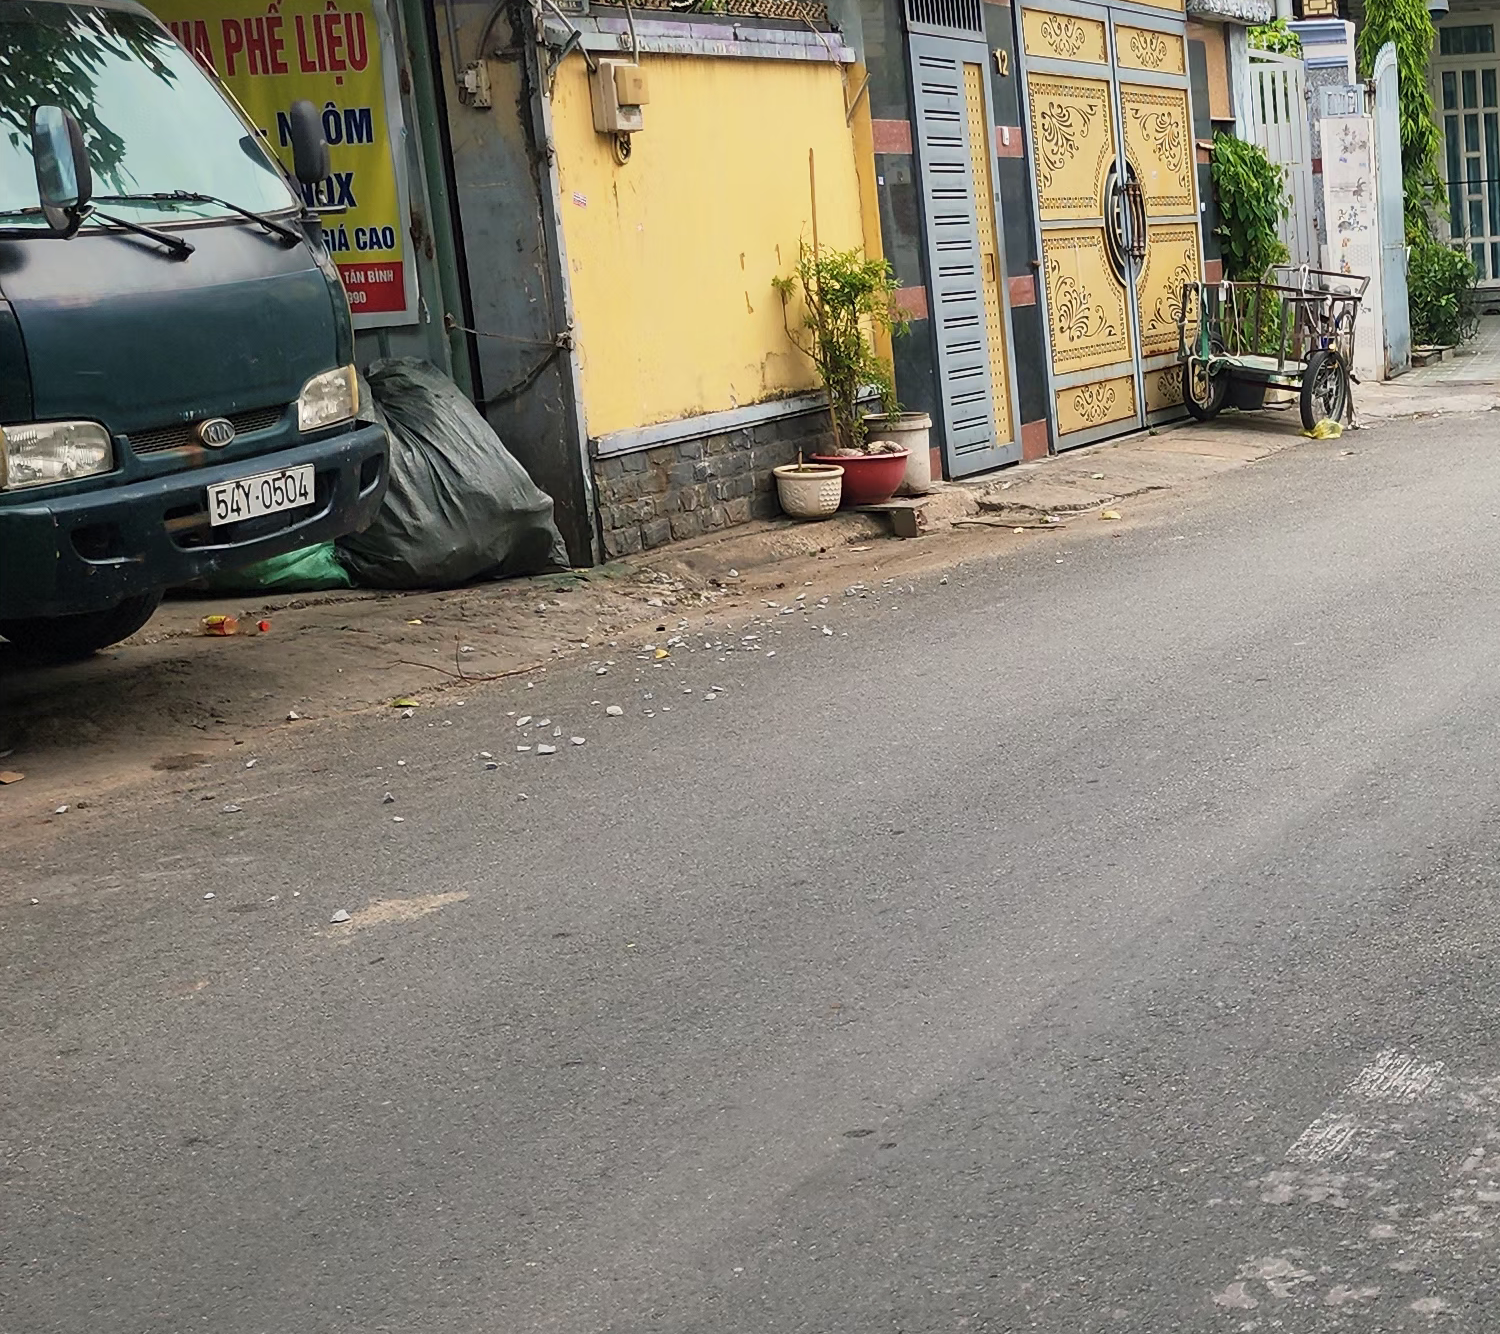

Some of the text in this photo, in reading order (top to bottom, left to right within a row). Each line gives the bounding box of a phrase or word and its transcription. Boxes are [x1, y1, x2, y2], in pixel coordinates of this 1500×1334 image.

[295, 0, 368, 85] LIỆU
[993, 49, 1009, 75] 12
[277, 102, 373, 147] NÔM
[355, 226, 395, 251] CAO
[368, 268, 394, 283] BÌNH
[207, 423, 232, 443] KIA
